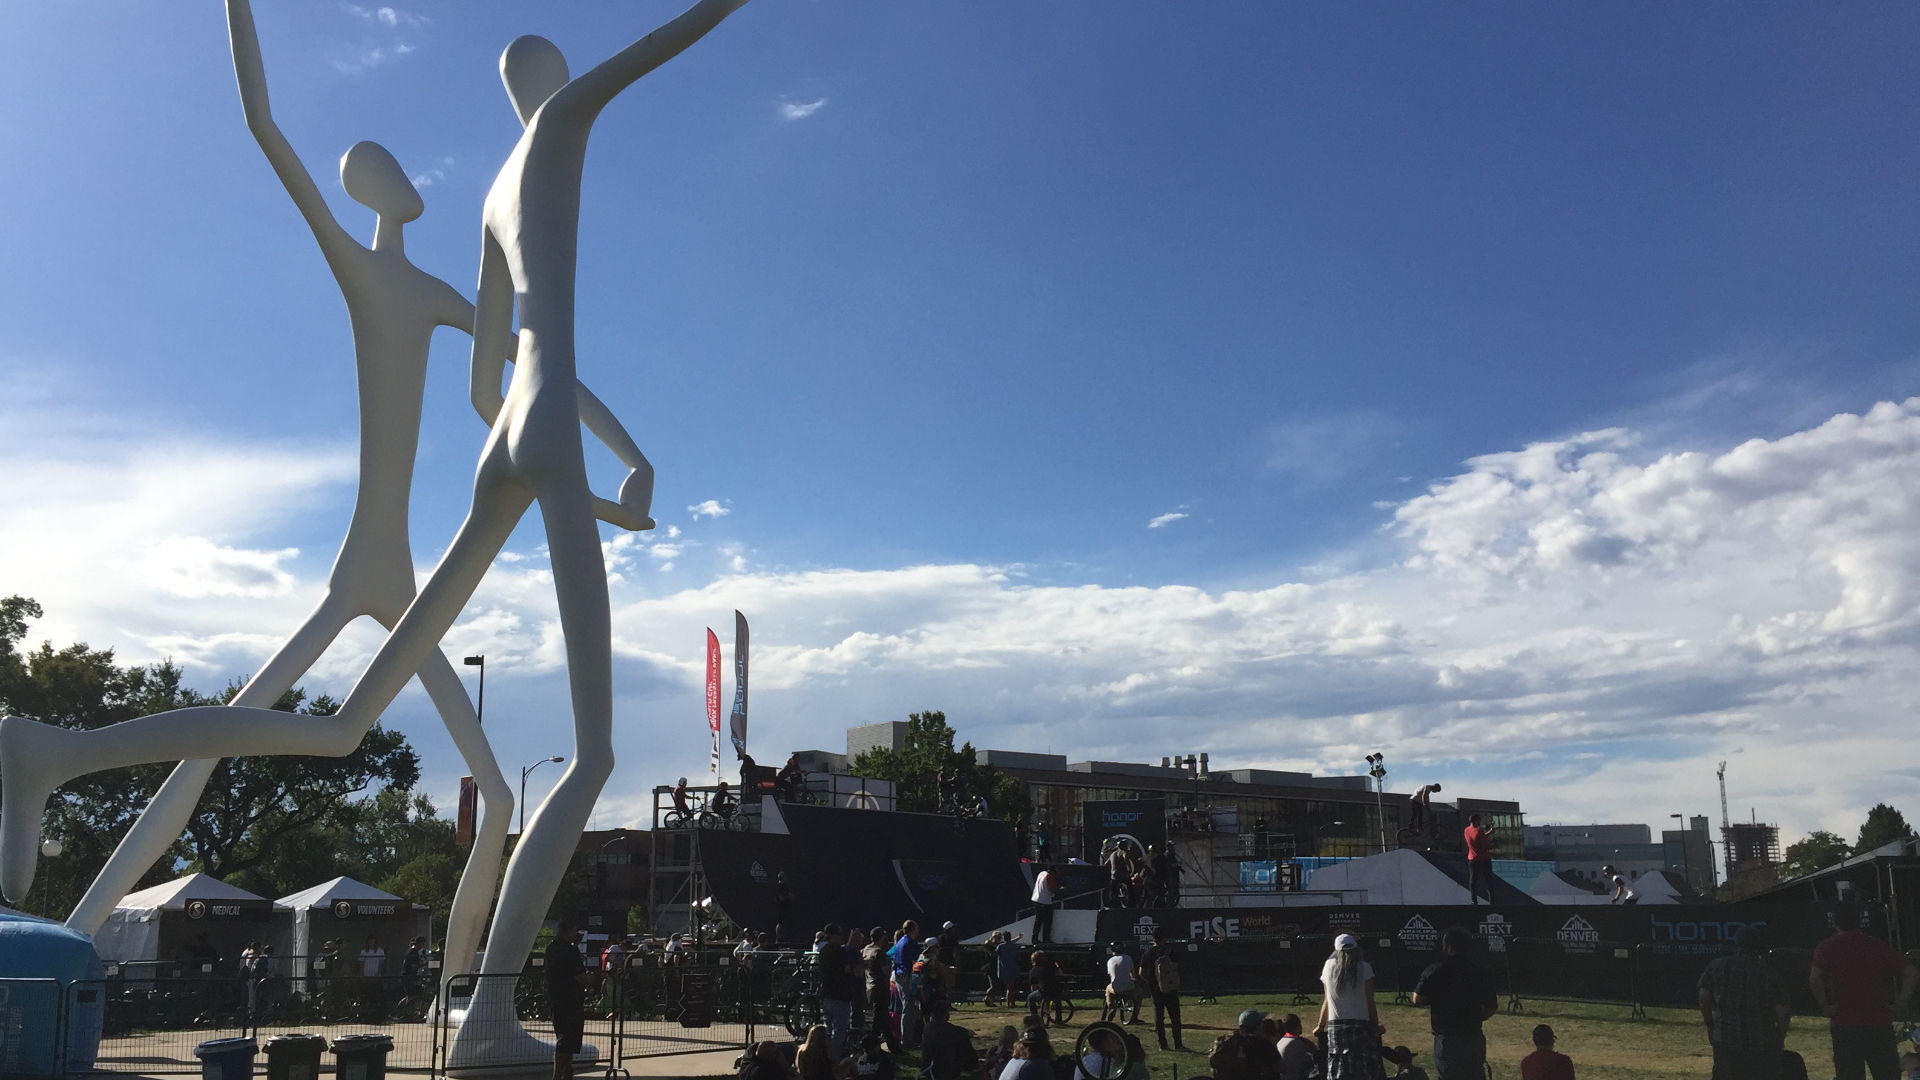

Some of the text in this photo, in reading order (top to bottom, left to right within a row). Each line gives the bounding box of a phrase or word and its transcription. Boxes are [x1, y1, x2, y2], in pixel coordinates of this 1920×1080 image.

[1102, 809, 1144, 822] honor
[211, 905, 241, 916] MEDICAL
[357, 905, 396, 915] VOLUNTEERS
[1189, 915, 1272, 943] FISE World
[1399, 929, 1439, 941] DENVER
[1556, 930, 1600, 942] DENVER
